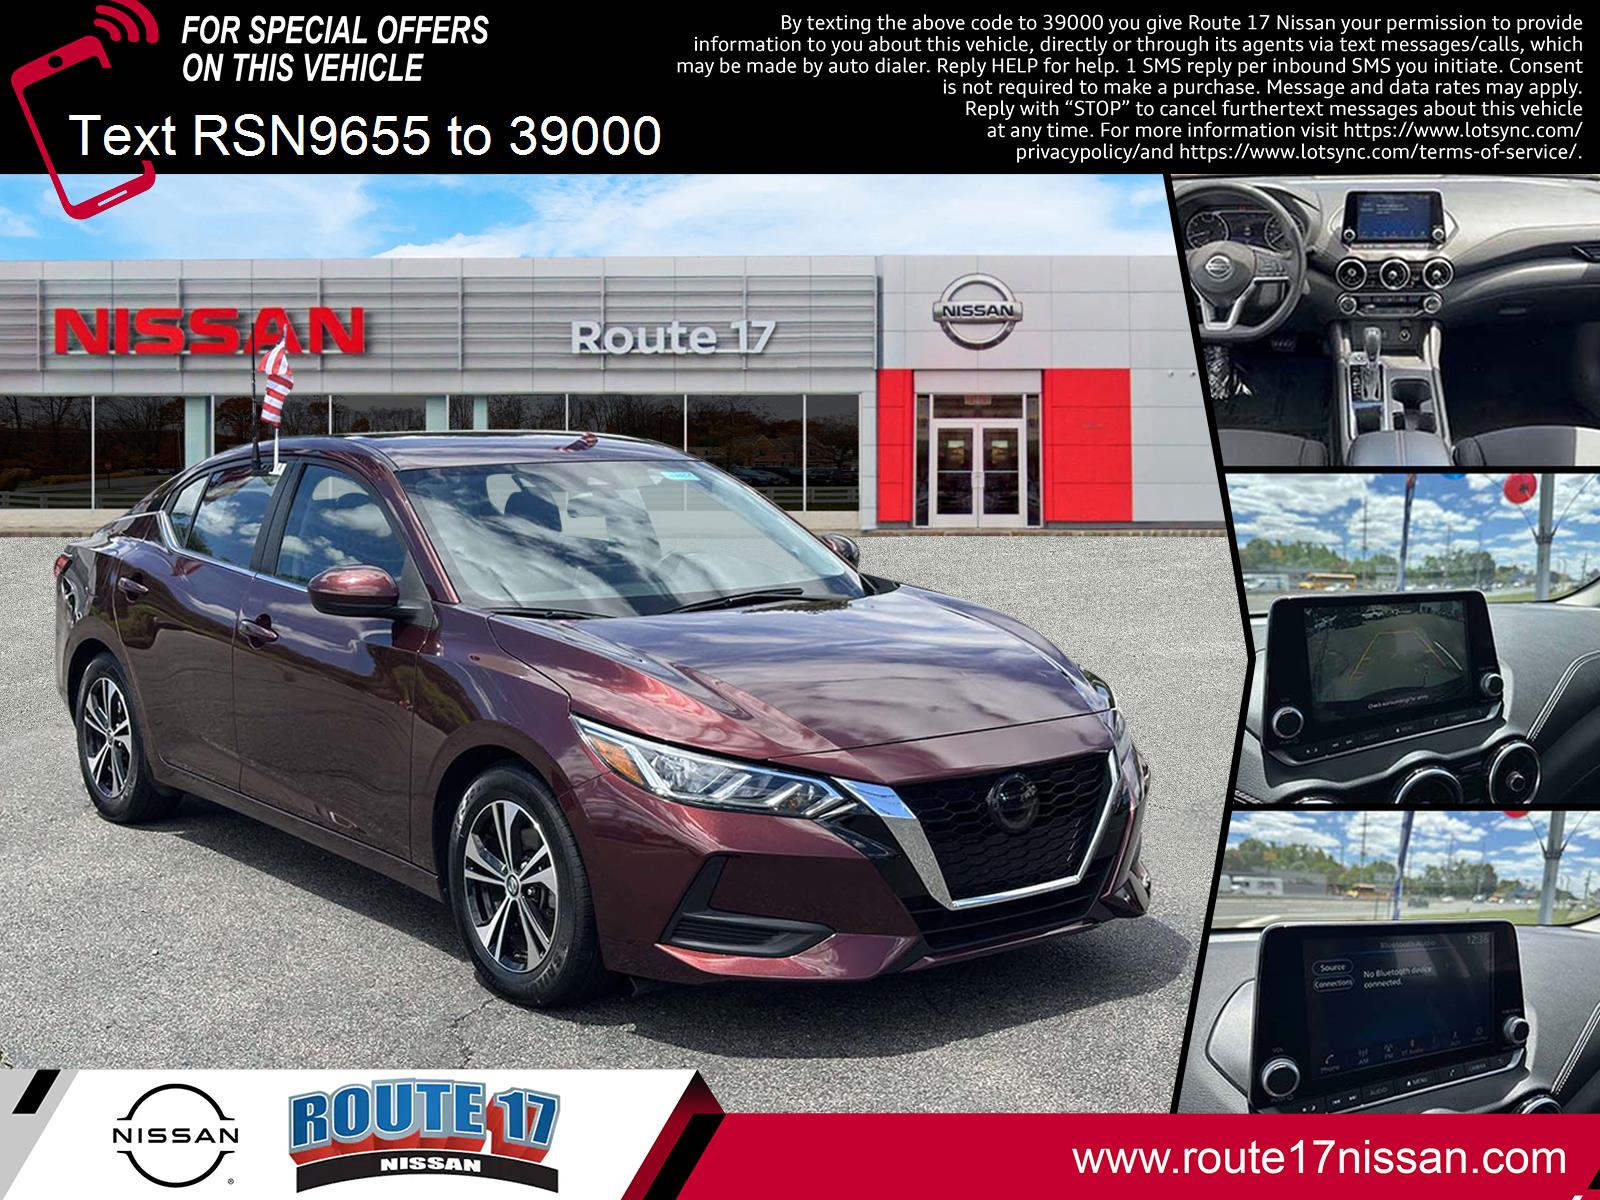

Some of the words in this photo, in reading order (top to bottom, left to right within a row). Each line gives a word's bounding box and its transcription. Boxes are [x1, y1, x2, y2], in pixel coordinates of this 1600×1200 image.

[942, 305, 1014, 317] NISSAN
[54, 307, 364, 354] NISSAN
[571, 321, 717, 354] Route
[730, 320, 776, 354] 17
